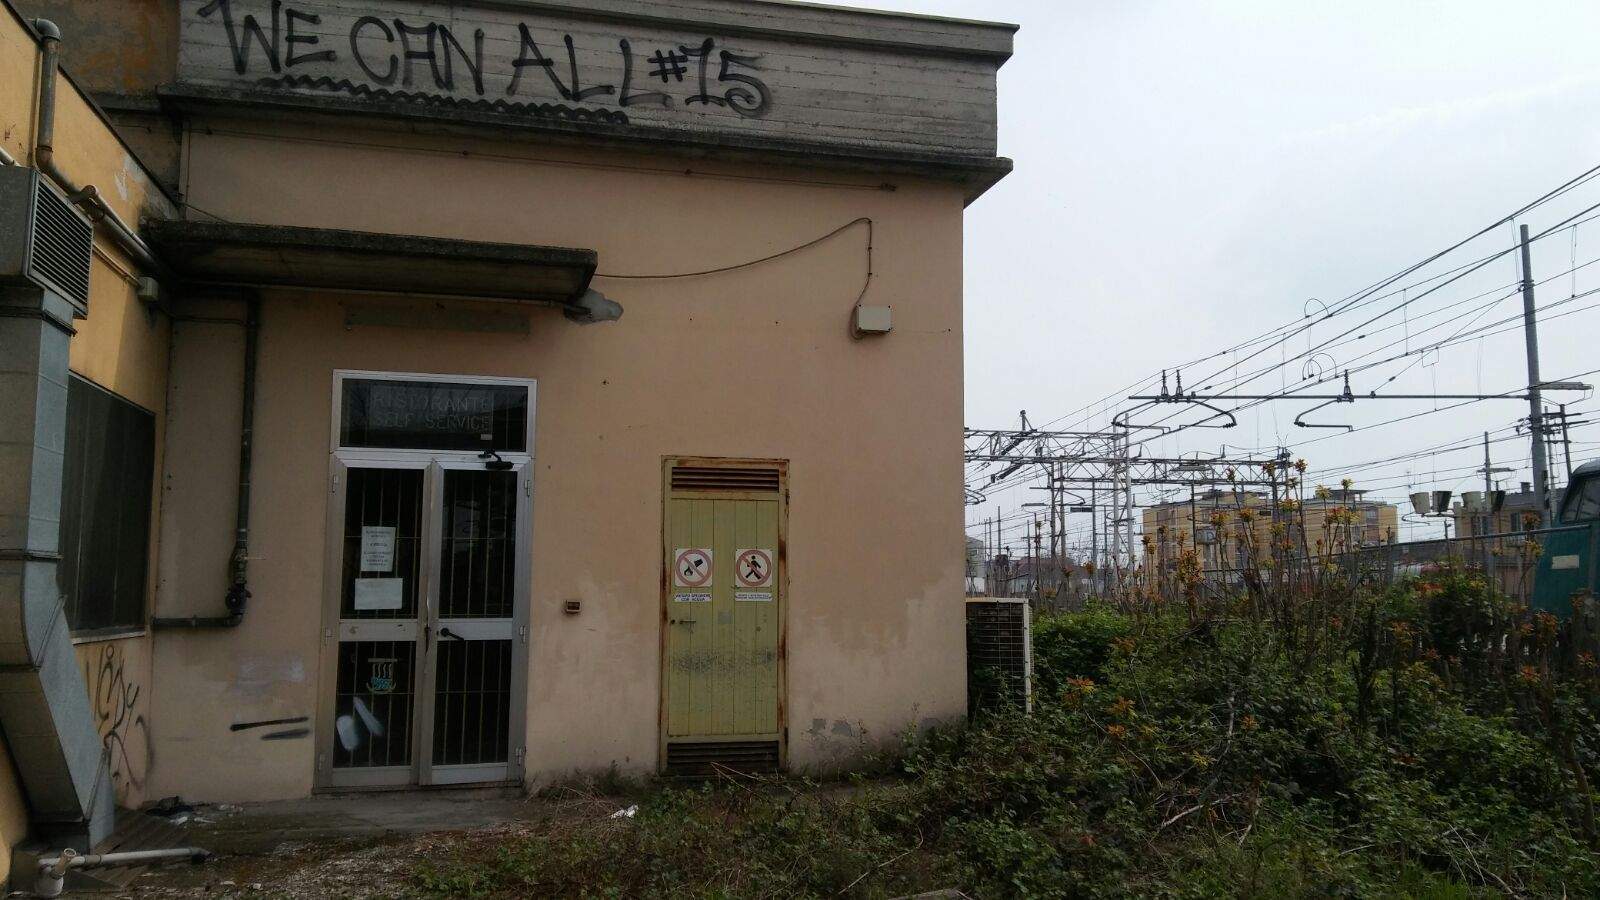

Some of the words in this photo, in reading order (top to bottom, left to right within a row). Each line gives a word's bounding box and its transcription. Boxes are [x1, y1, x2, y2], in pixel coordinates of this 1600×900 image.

[200, 0, 336, 76] WE
[507, 22, 673, 108] ALL
[648, 37, 771, 118] #15
[424, 414, 490, 430] SERVICE
